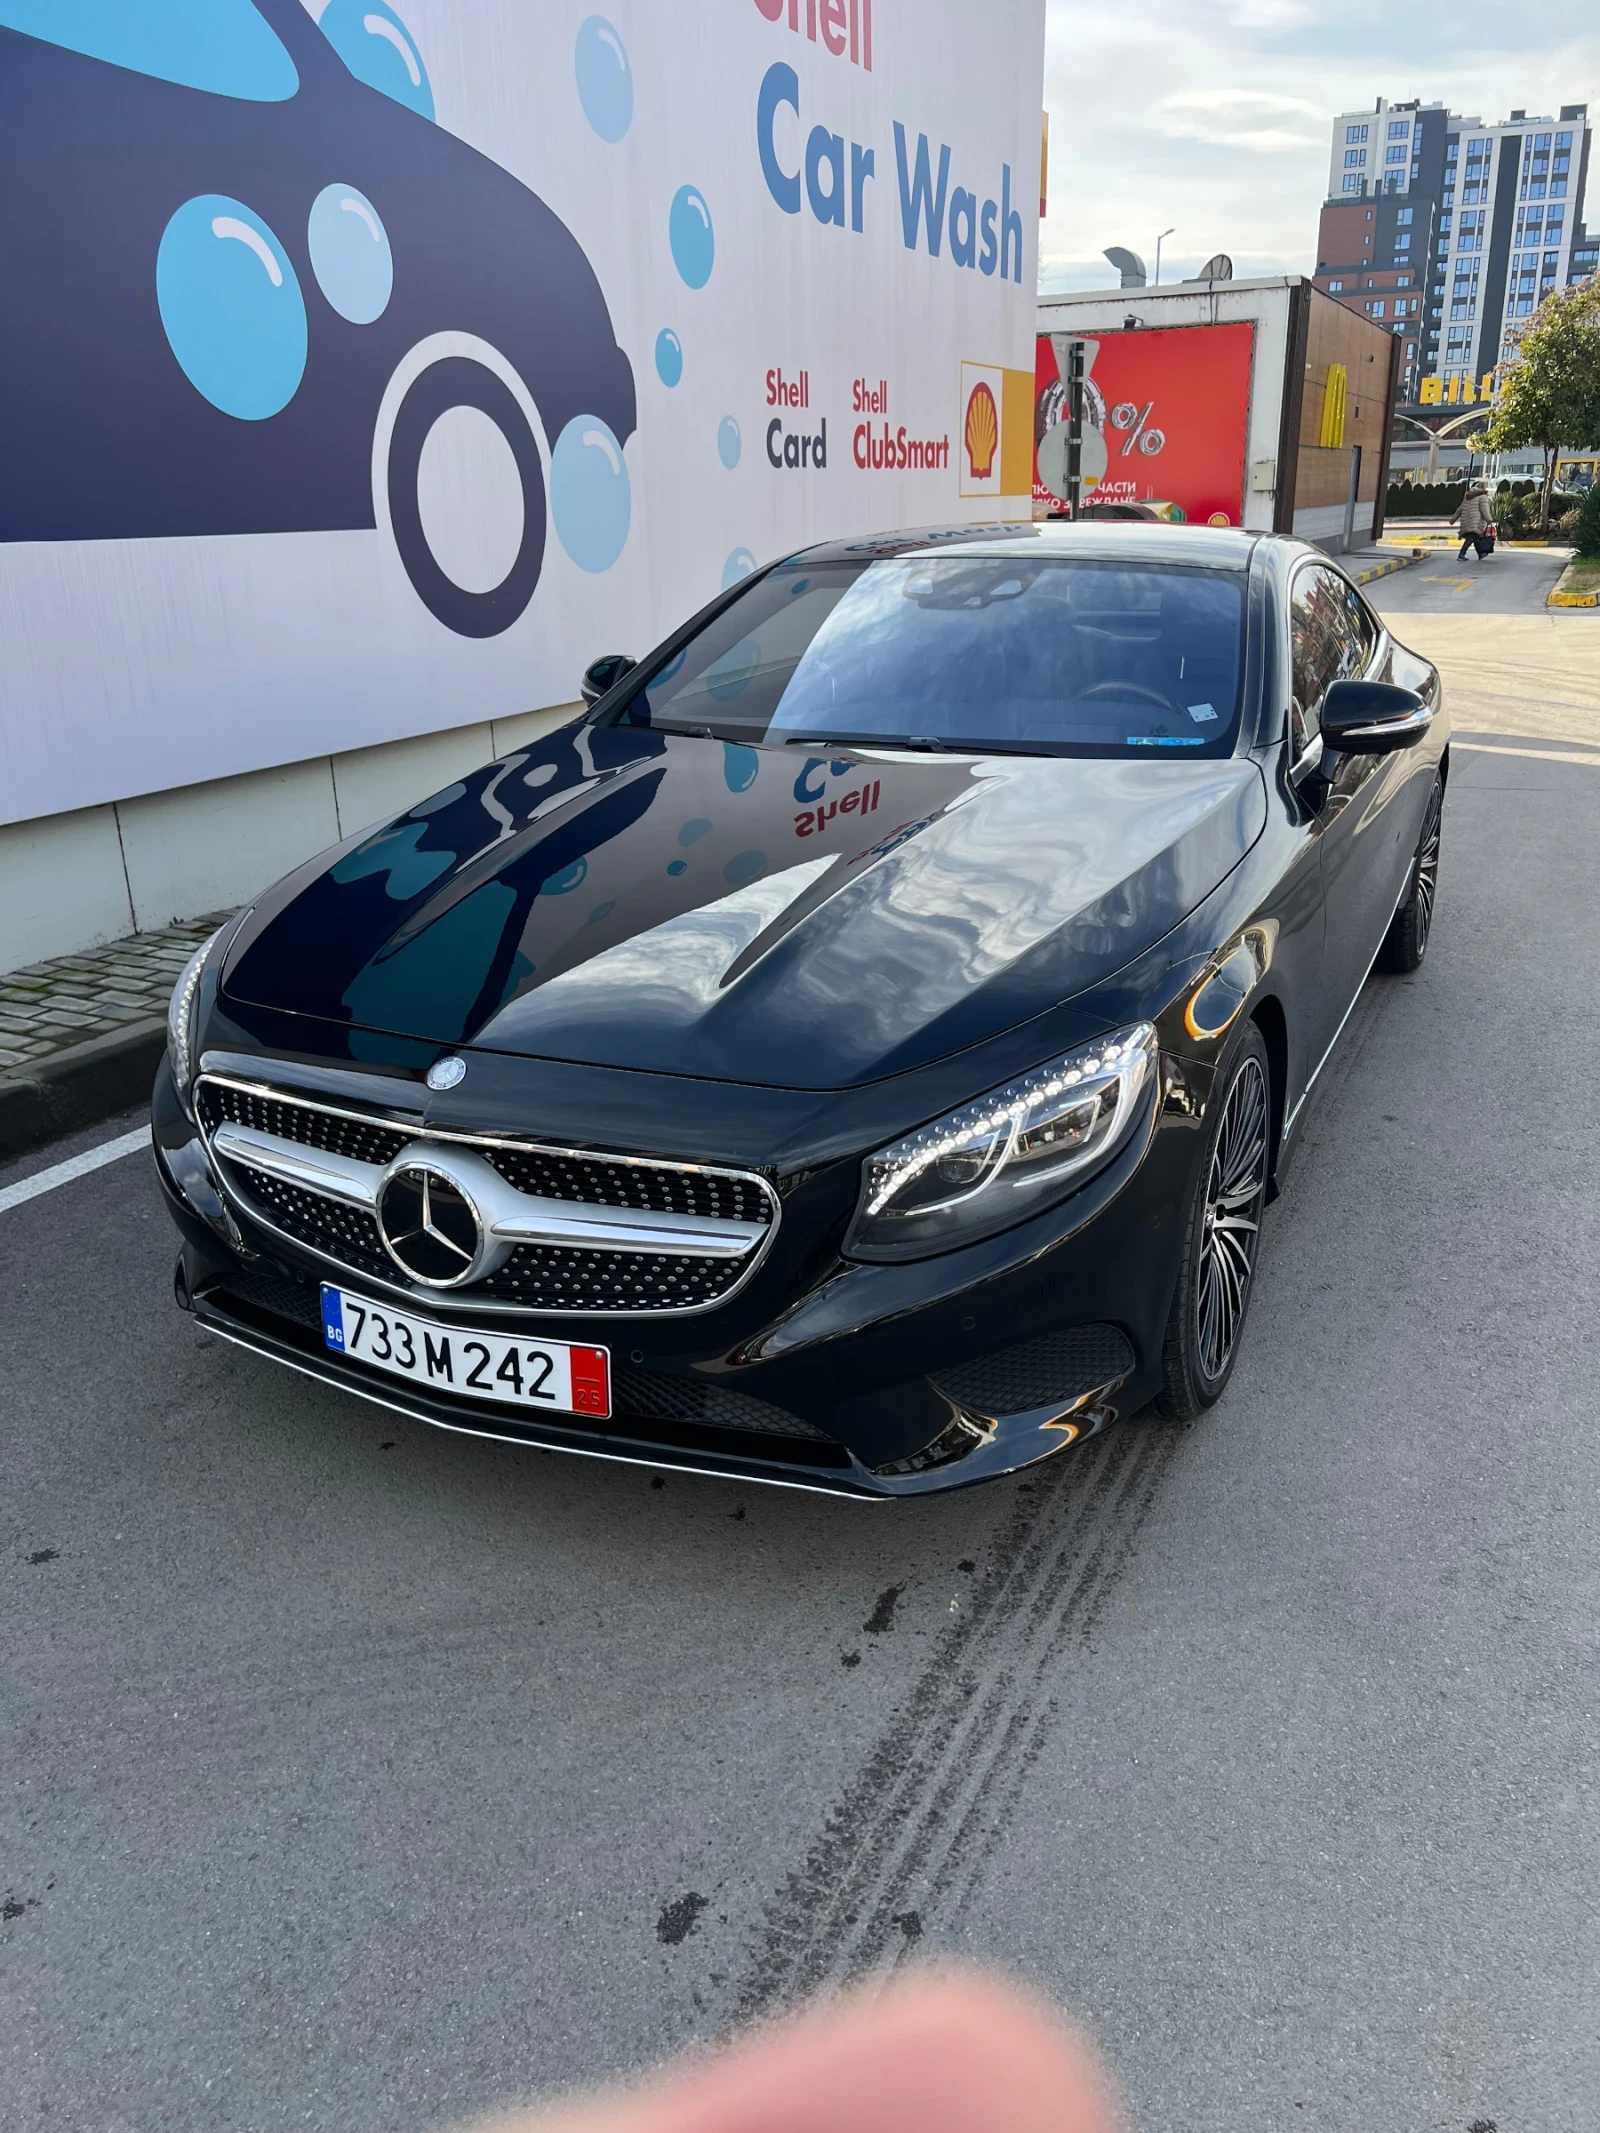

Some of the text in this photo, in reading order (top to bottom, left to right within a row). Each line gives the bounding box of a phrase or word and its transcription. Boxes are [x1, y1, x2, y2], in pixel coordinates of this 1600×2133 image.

[753, 0, 872, 73] ell
[757, 61, 1022, 285] Car Wash
[766, 368, 809, 408] Shell
[852, 378, 888, 414] Shell
[766, 417, 828, 469] Card
[853, 421, 950, 471] ClubSmart
[327, 1325, 343, 1343] BG
[577, 1388, 601, 1408] 25
